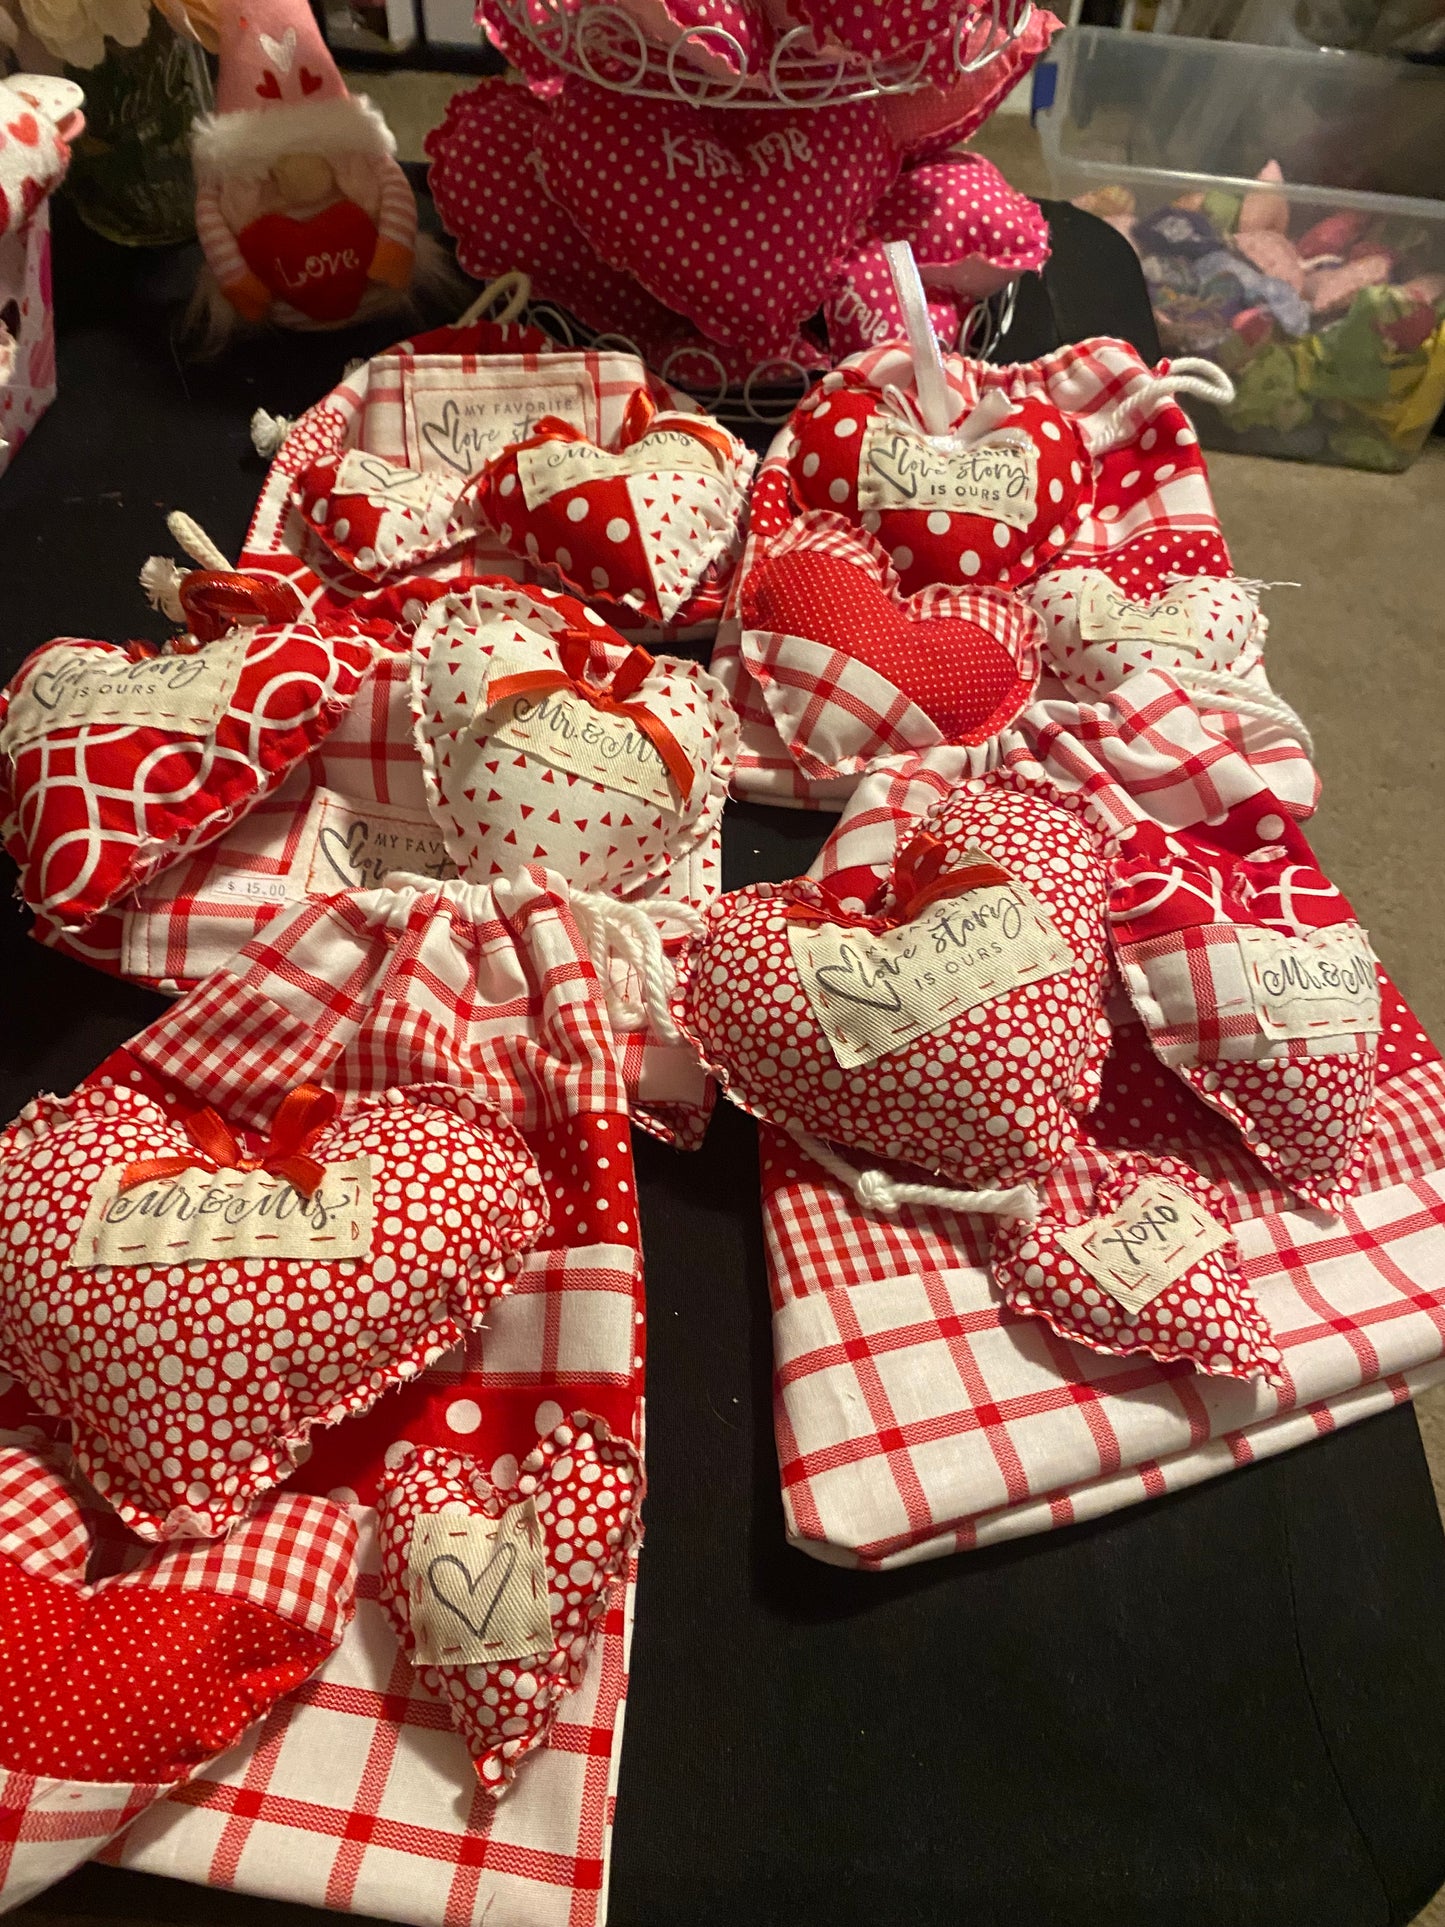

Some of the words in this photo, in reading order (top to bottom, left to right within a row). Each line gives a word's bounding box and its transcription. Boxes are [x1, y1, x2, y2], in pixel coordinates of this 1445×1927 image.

[274, 248, 360, 288] Love
[464, 404, 487, 417] MY
[494, 400, 573, 415] FAVORITE
[451, 417, 501, 455] love
[956, 457, 1030, 498] story
[931, 484, 947, 496] IS
[955, 485, 1001, 501] OURS
[99, 684, 156, 696] OURS
[581, 722, 606, 745] &
[374, 833, 398, 849] MY
[246, 881, 287, 897] 15.00
[928, 896, 1023, 953] story
[914, 972, 937, 991] IS
[944, 941, 1003, 975] OURS
[1317, 960, 1341, 987] &
[197, 1188, 236, 1214] &
